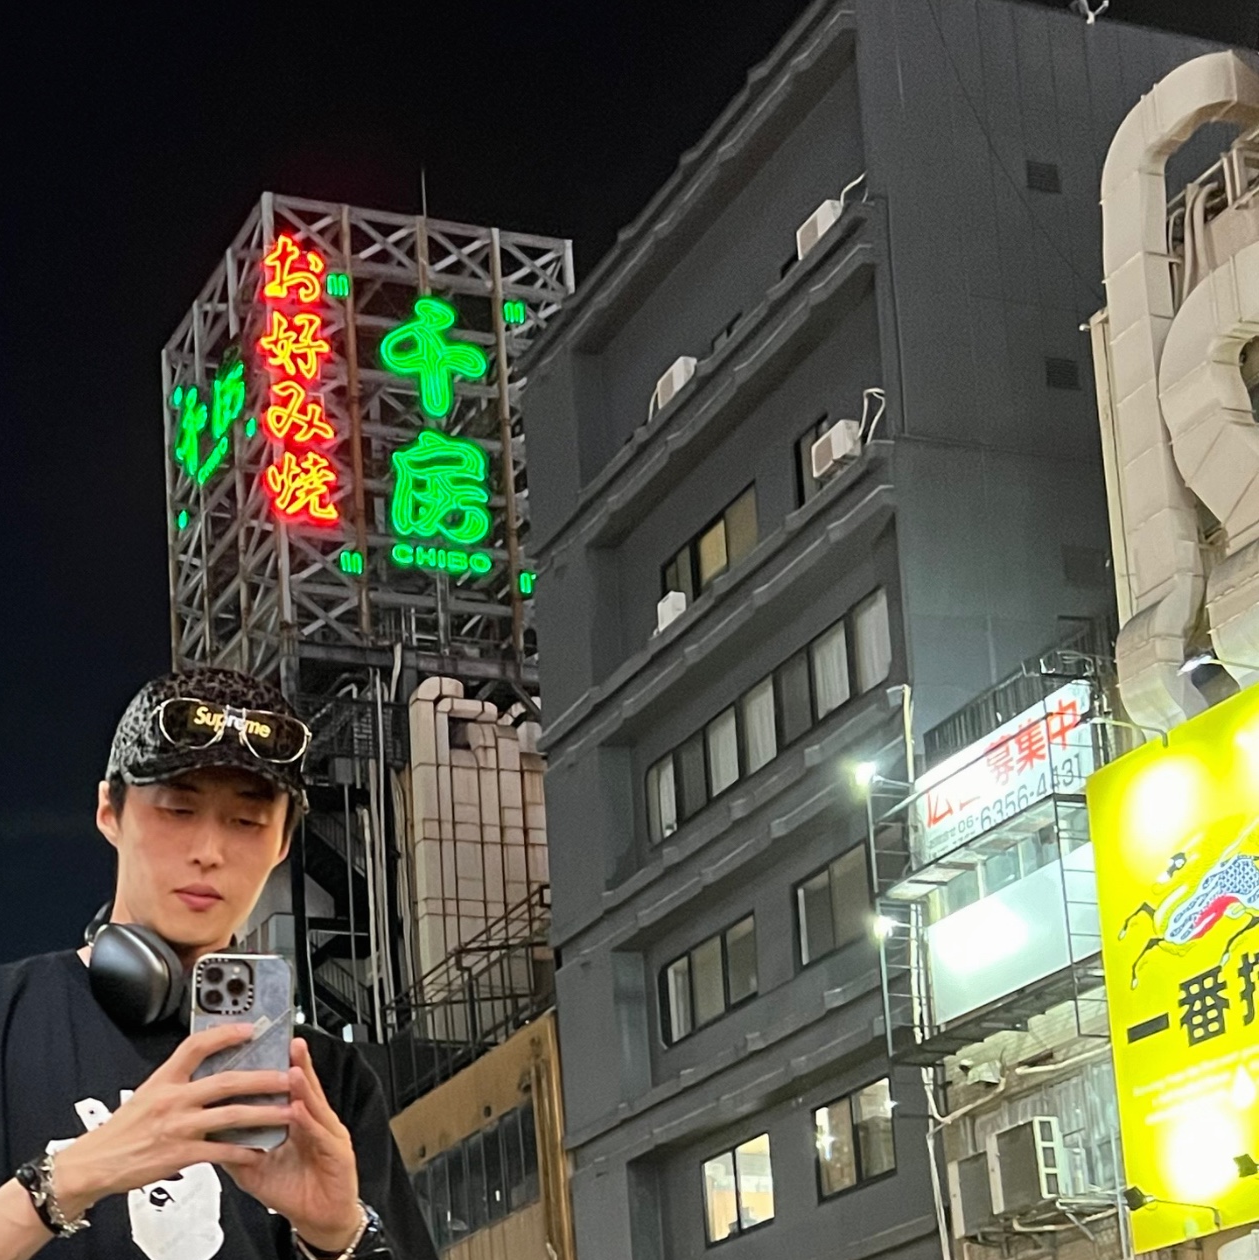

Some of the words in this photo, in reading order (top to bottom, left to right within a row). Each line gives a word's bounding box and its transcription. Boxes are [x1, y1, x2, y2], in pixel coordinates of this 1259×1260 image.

[260, 234, 338, 519] お好み焼
[378, 298, 489, 543] 千房
[392, 543, 492, 573] CHIBO
[193, 705, 272, 739] Supreme
